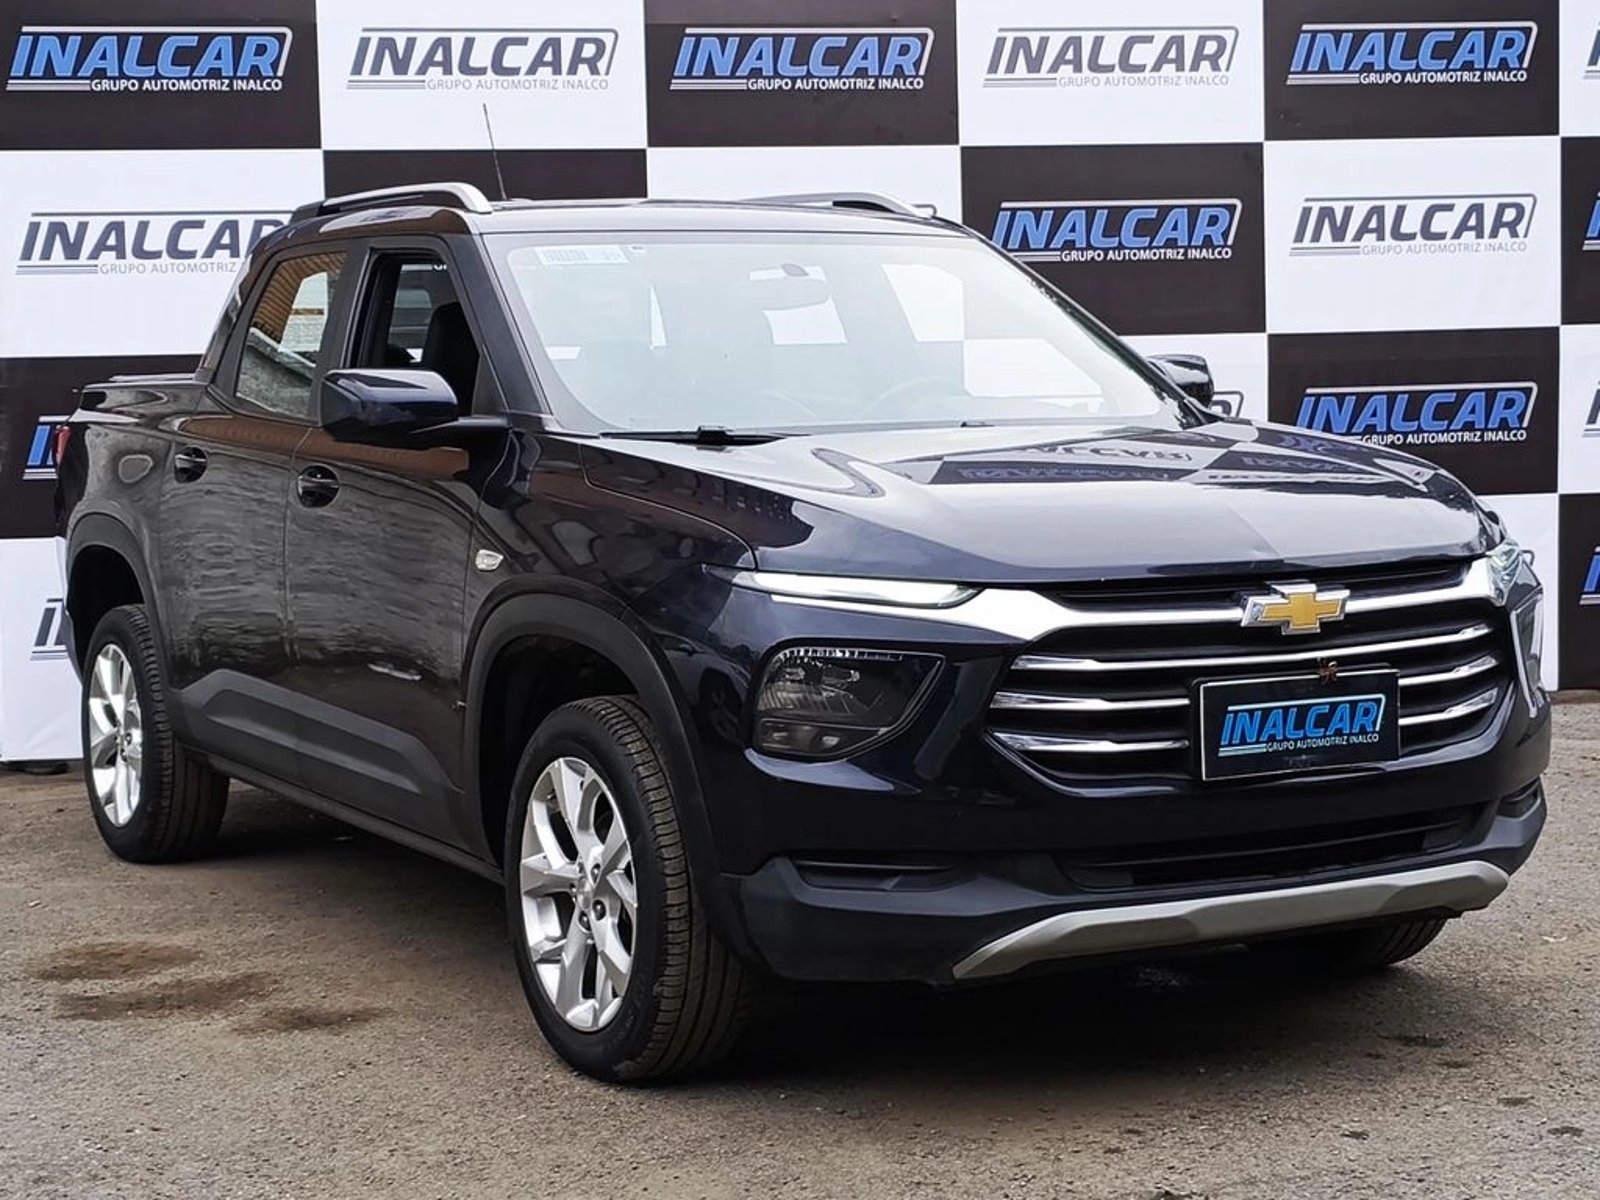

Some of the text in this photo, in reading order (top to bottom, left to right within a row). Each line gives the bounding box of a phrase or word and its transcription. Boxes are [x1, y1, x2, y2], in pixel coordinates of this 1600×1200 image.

[10, 33, 281, 77] INALCAR
[350, 36, 607, 76] INALCAR
[673, 36, 923, 77] INALCAR
[987, 35, 1227, 74] INALCAR
[1290, 30, 1527, 73] INALCAR
[91, 78, 283, 92] GRUPO AUTOMOTRIZ INALCO
[427, 78, 609, 91] GRUPO AUTOMOTRIZ INALCO
[748, 77, 924, 91] GRUPO AUTOMOTRIZ INALCO
[1058, 74, 1229, 88] GRUPO AUTOMOTRIZ INALCO
[1360, 69, 1527, 85] GRUPO AUTOMOTRIZ INALCO
[992, 207, 1231, 250] INALCAR
[1294, 202, 1525, 243] INALCAR
[1062, 247, 1231, 262] GRUPO AUTOMOTRIZ INALCO
[1361, 241, 1527, 255] GRUPO AUTOMOTRIZ INALCO
[100, 261, 236, 275] GRUPO AUTOMOTRIZ
[1296, 390, 1526, 433] INALCAR
[1362, 429, 1526, 445] GRUPO AUTOMOTRIZ INALCO
[1220, 702, 1378, 746] INALCAR
[1267, 733, 1379, 752] GRUPO AUTOMOTRIZ INALCO
